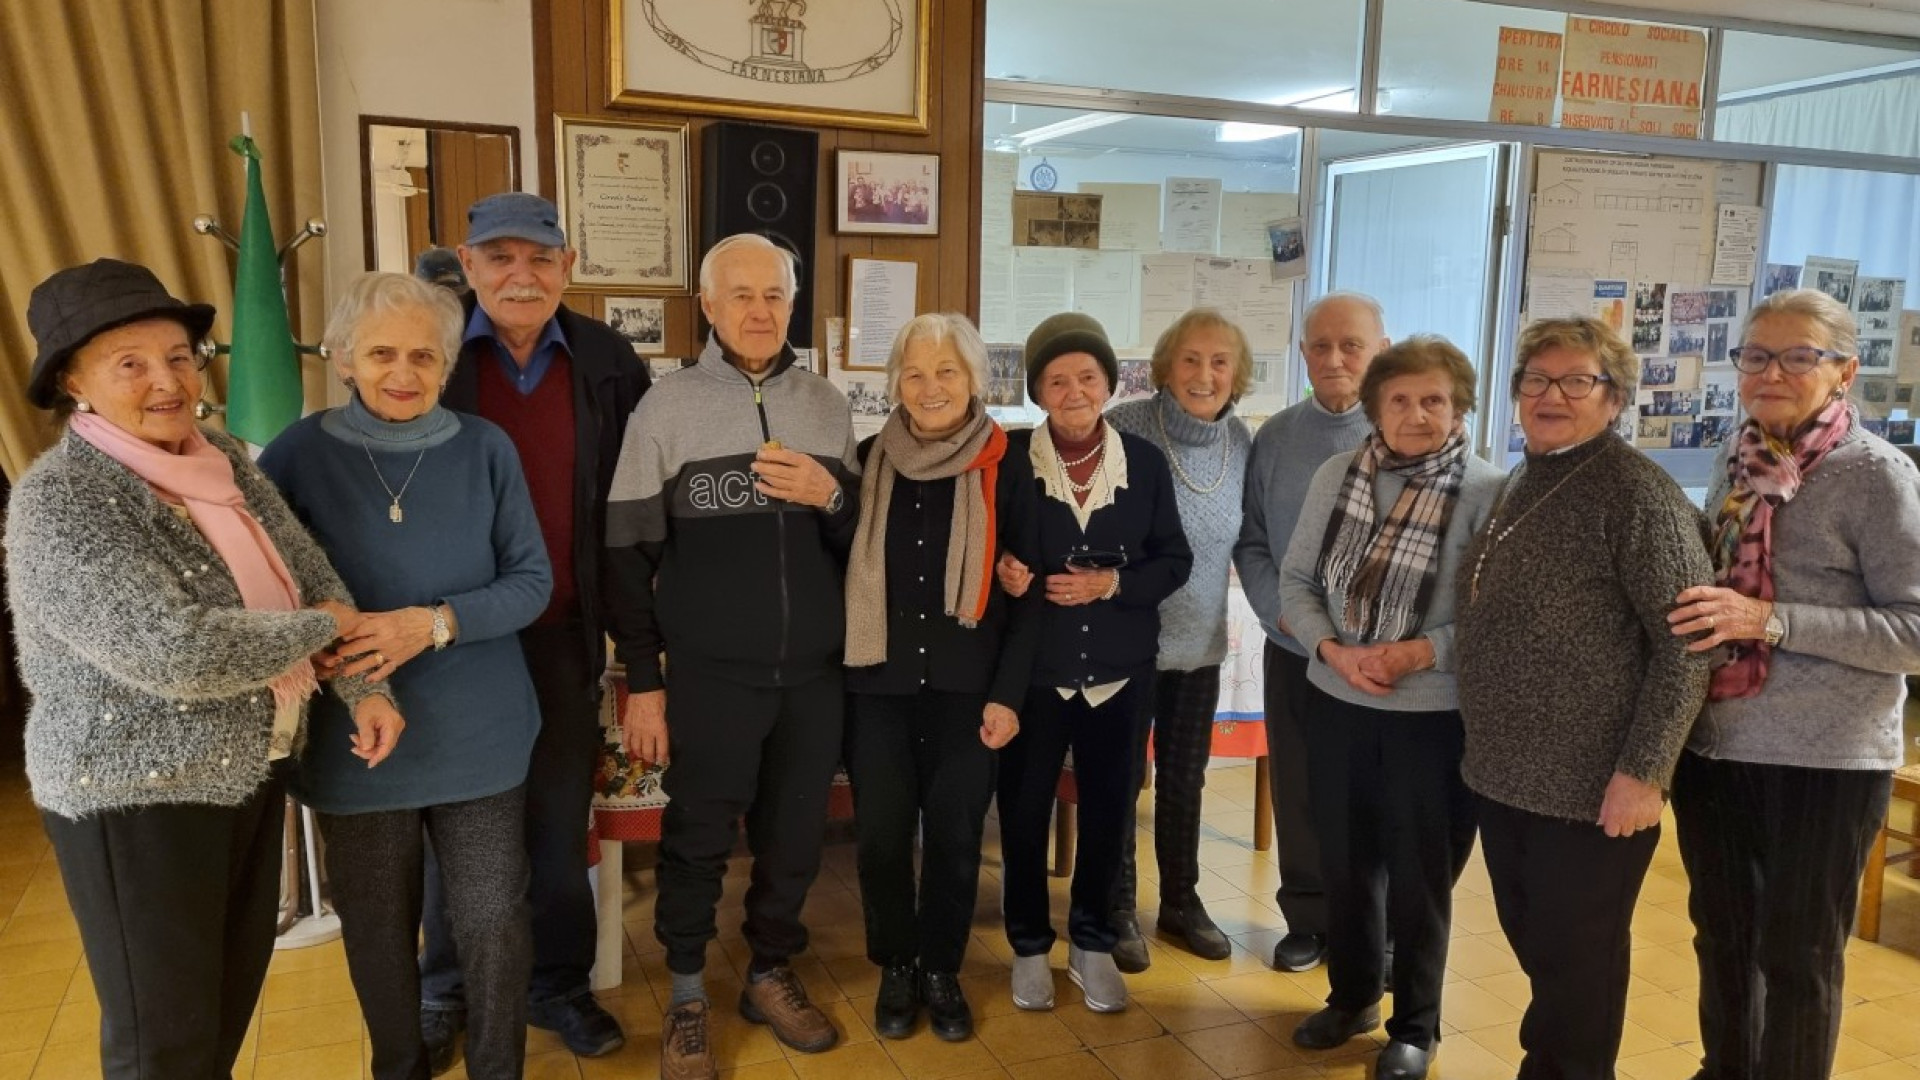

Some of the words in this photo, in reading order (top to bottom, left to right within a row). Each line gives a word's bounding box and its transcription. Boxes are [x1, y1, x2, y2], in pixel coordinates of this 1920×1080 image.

[1500, 30, 1562, 49] APERTURA
[1589, 20, 1630, 36] CIRCOLO
[1647, 26, 1690, 42] SOCIALE
[1499, 56, 1523, 72] ORE
[1600, 51, 1658, 69] PENSIONATI
[731, 60, 826, 84] FARNESIANA
[1494, 82, 1553, 99] CHIUSURA
[1562, 71, 1700, 107] FARNESIANA
[1562, 113, 1614, 130] RISERVATO
[1640, 121, 1662, 134] SOLI
[1672, 123, 1696, 137] SOCI
